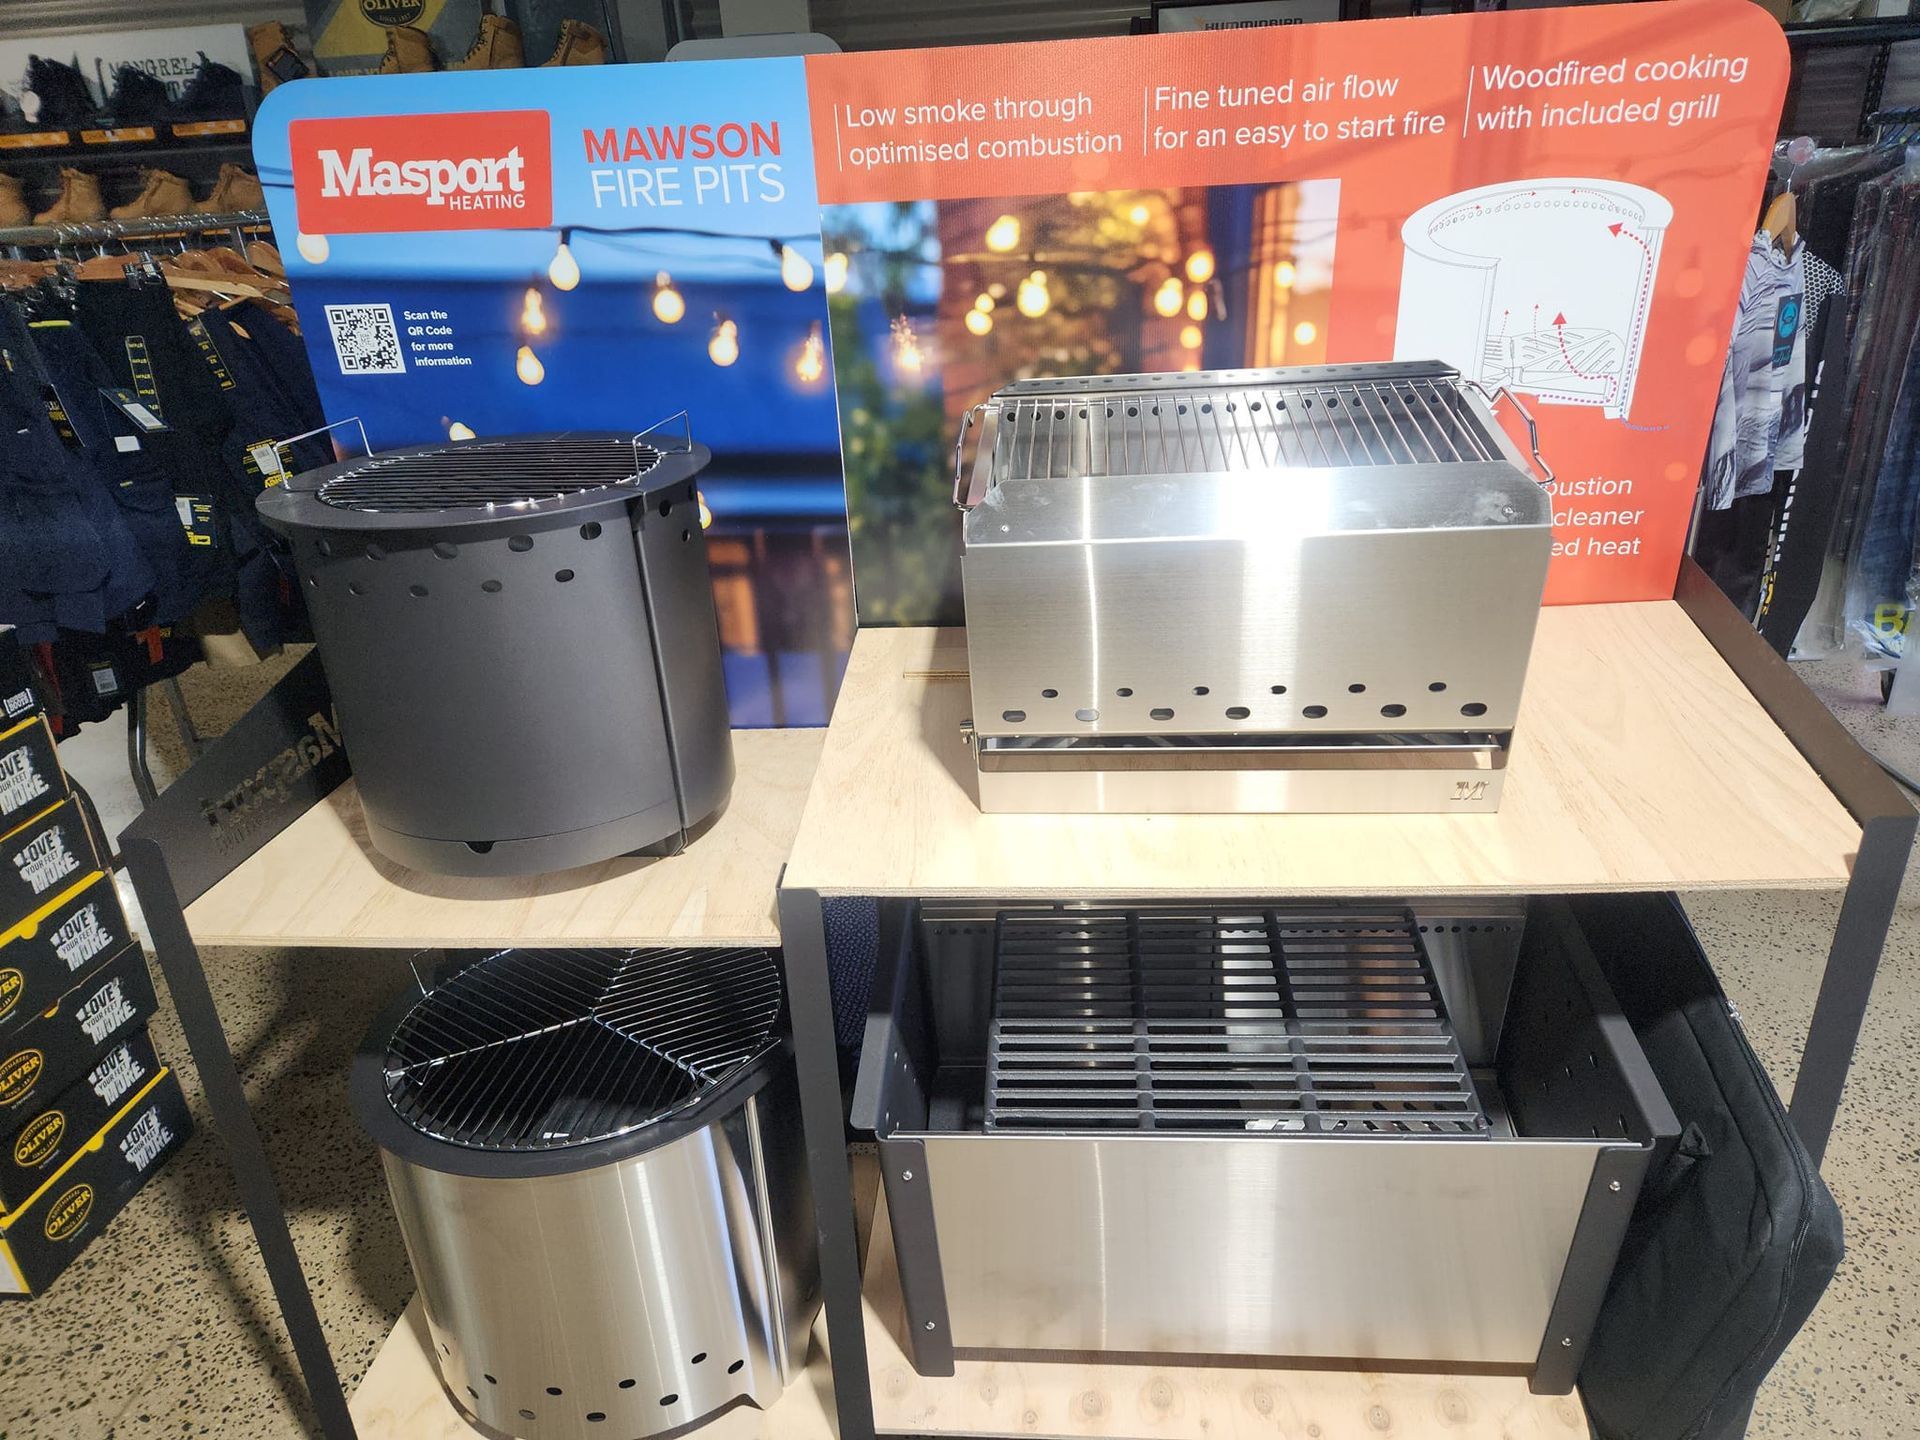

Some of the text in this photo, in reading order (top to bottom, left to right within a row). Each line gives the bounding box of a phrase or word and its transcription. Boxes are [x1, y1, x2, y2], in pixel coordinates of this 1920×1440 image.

[1482, 53, 1749, 91] Woodfired cooking
[846, 91, 1093, 128] Low smoke through
[1155, 74, 1399, 110] Fine tuned air flow
[1153, 110, 1447, 150] for an easy to start fire
[1476, 93, 1722, 131] with included grill
[583, 121, 781, 163] MAWSON
[849, 130, 1123, 171] optimised combustion
[318, 146, 525, 206] Masport
[591, 162, 785, 209] FIRE PITS
[449, 193, 526, 211] HEATING
[403, 310, 448, 321] Scan the
[407, 325, 453, 337] QR Code
[411, 341, 454, 352] for more
[414, 355, 473, 367] information
[1553, 507, 1645, 527] cleaner
[1587, 537, 1641, 556] heat
[0, 752, 24, 781] OVE
[21, 831, 56, 868] LOVE
[25, 850, 59, 876] YOUR FEET
[58, 909, 91, 946] LOVE
[61, 927, 94, 954] YOUR FEET
[82, 984, 116, 1019] LOVE
[86, 1000, 118, 1028] YOUR FEET
[0, 1056, 40, 1093] LIVER
[94, 1047, 125, 1084] LOVE
[18, 1117, 62, 1159] OLIVER
[48, 1190, 90, 1234] OLIVER
